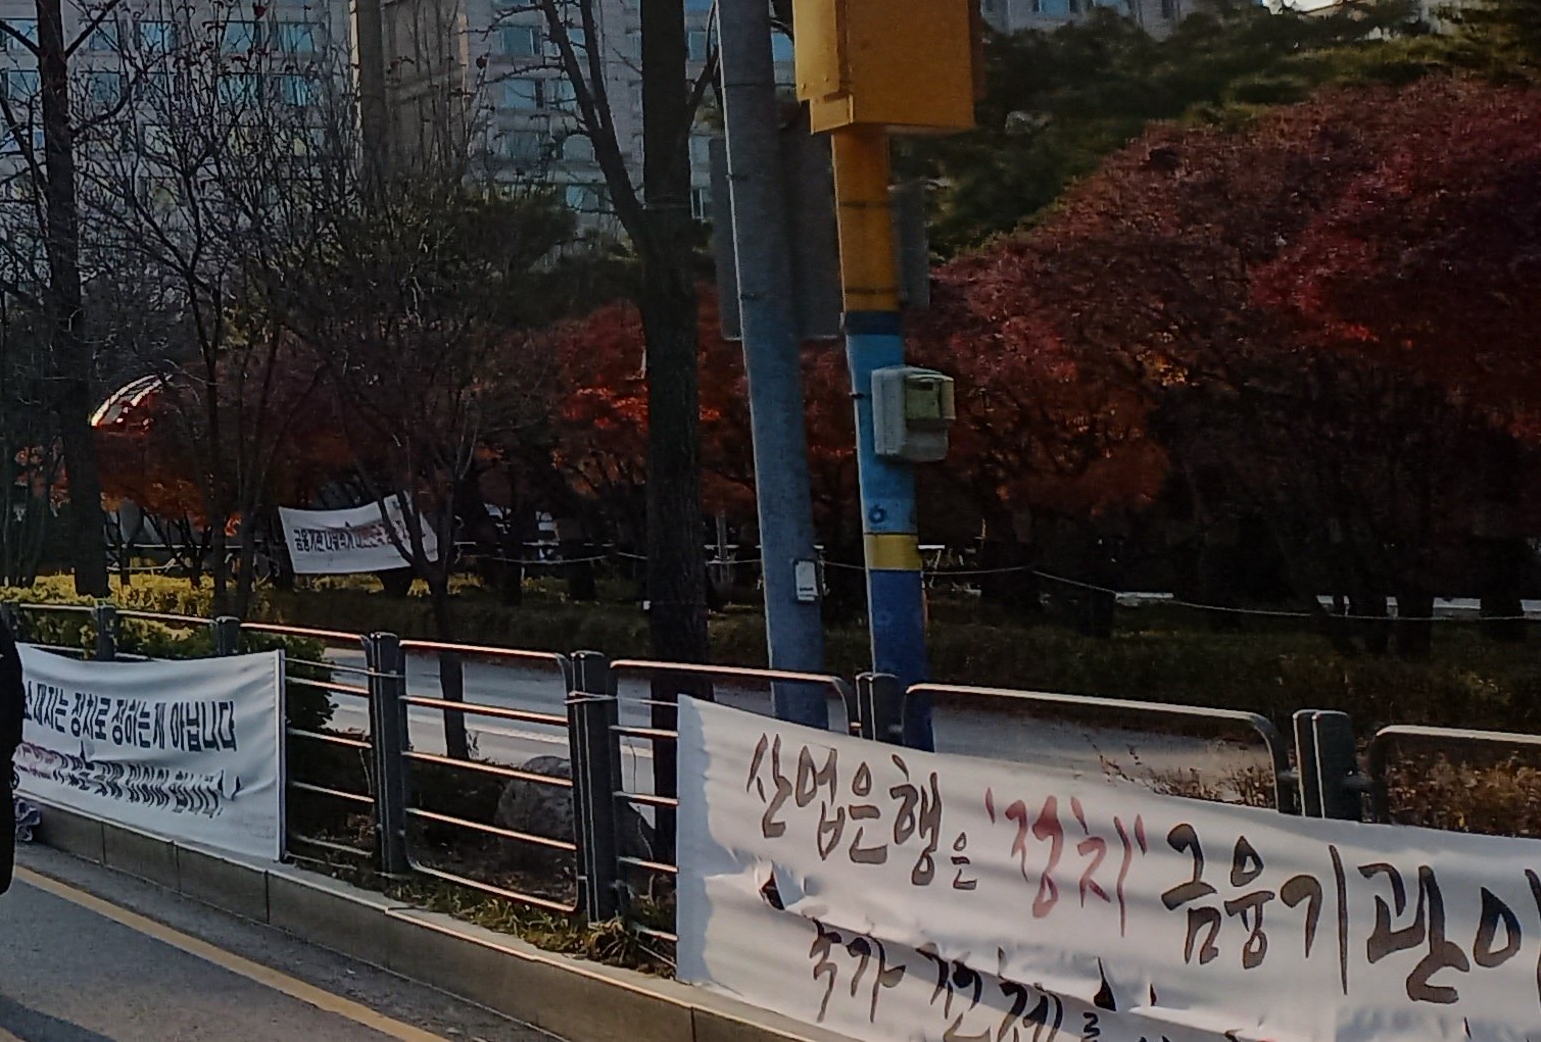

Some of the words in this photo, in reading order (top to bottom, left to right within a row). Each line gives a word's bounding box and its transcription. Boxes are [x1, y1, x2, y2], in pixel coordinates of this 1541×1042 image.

[71, 692, 111, 741] 정치로
[170, 700, 237, 752] 아닙니다
[746, 733, 977, 890] 산업은행은
